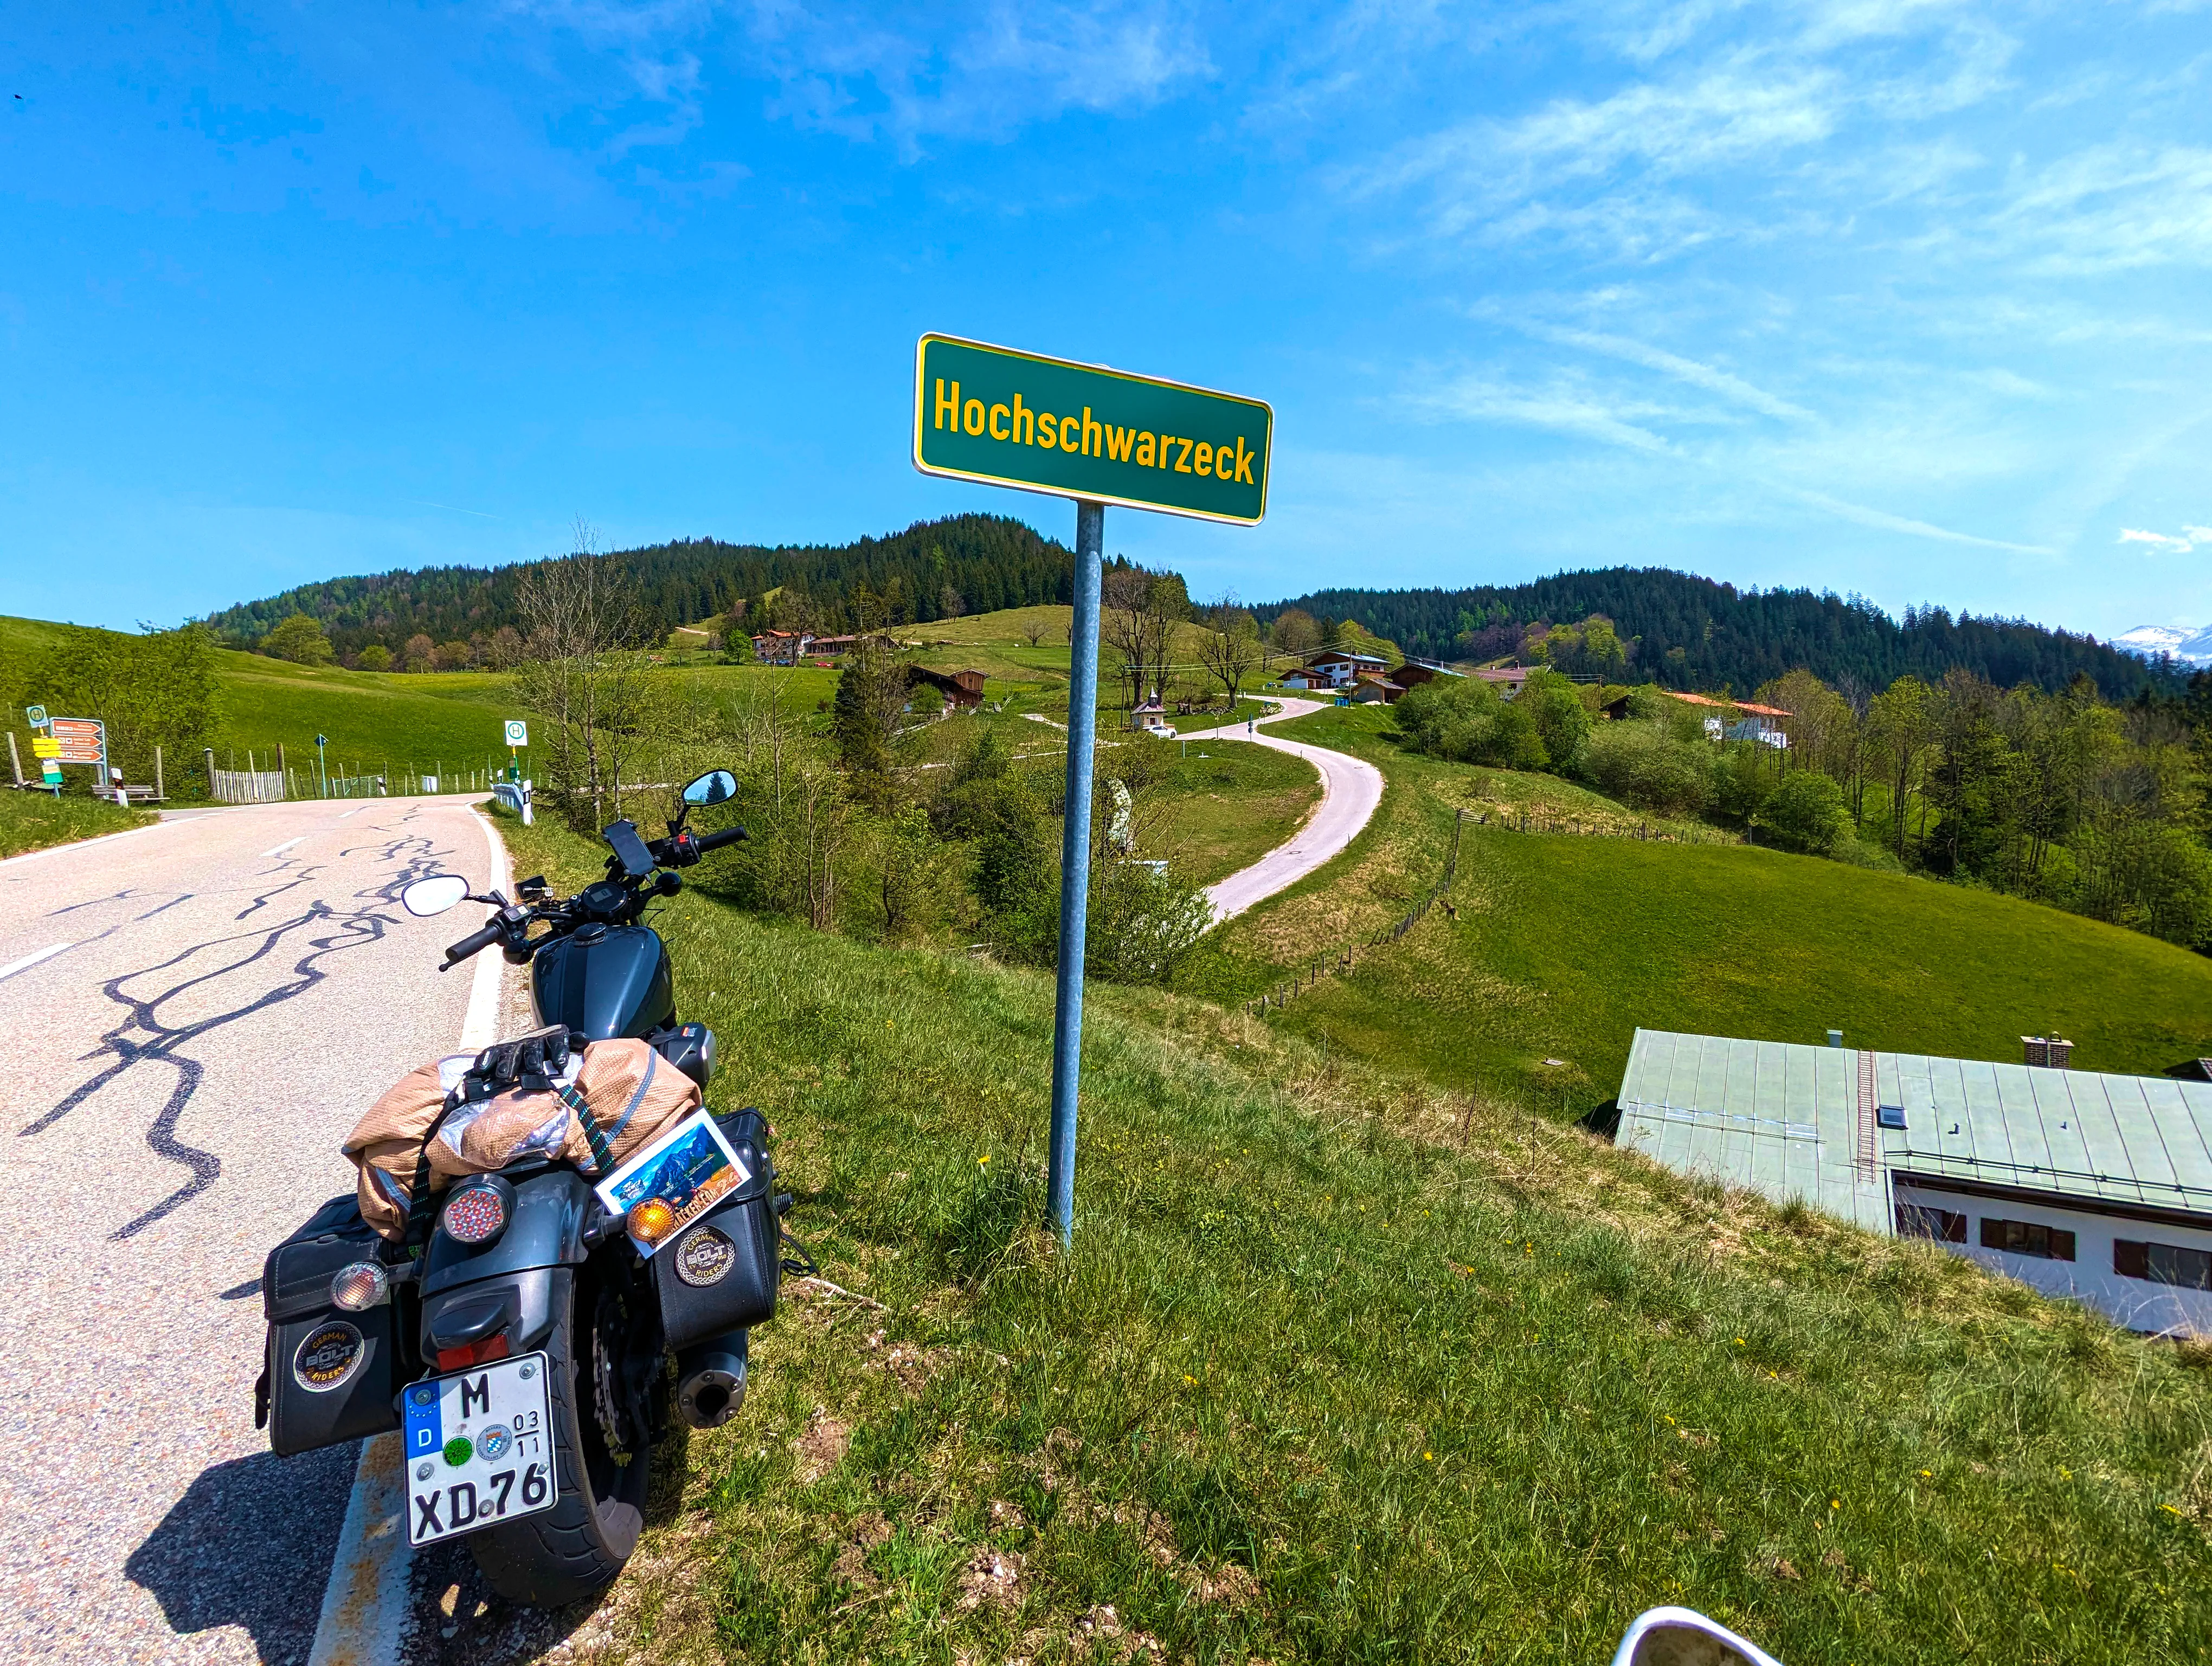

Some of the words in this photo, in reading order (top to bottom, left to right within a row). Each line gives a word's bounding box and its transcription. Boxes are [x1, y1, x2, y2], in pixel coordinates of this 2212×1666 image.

[935, 378, 1256, 484] Hochschwarzeck
[512, 726, 519, 735] H
[687, 1234, 718, 1251] GERMAN
[686, 1245, 725, 1265] BOLT
[695, 1263, 723, 1277] RIDERS
[312, 1332, 346, 1349] GERMAN
[306, 1344, 354, 1367] BOLT
[311, 1366, 344, 1381] RIDERS
[461, 1373, 490, 1418] M
[515, 1411, 539, 1431] 03
[418, 1428, 432, 1448] D
[518, 1437, 539, 1457] 11
[415, 1481, 477, 1539] XD
[491, 1462, 547, 1515] 76
